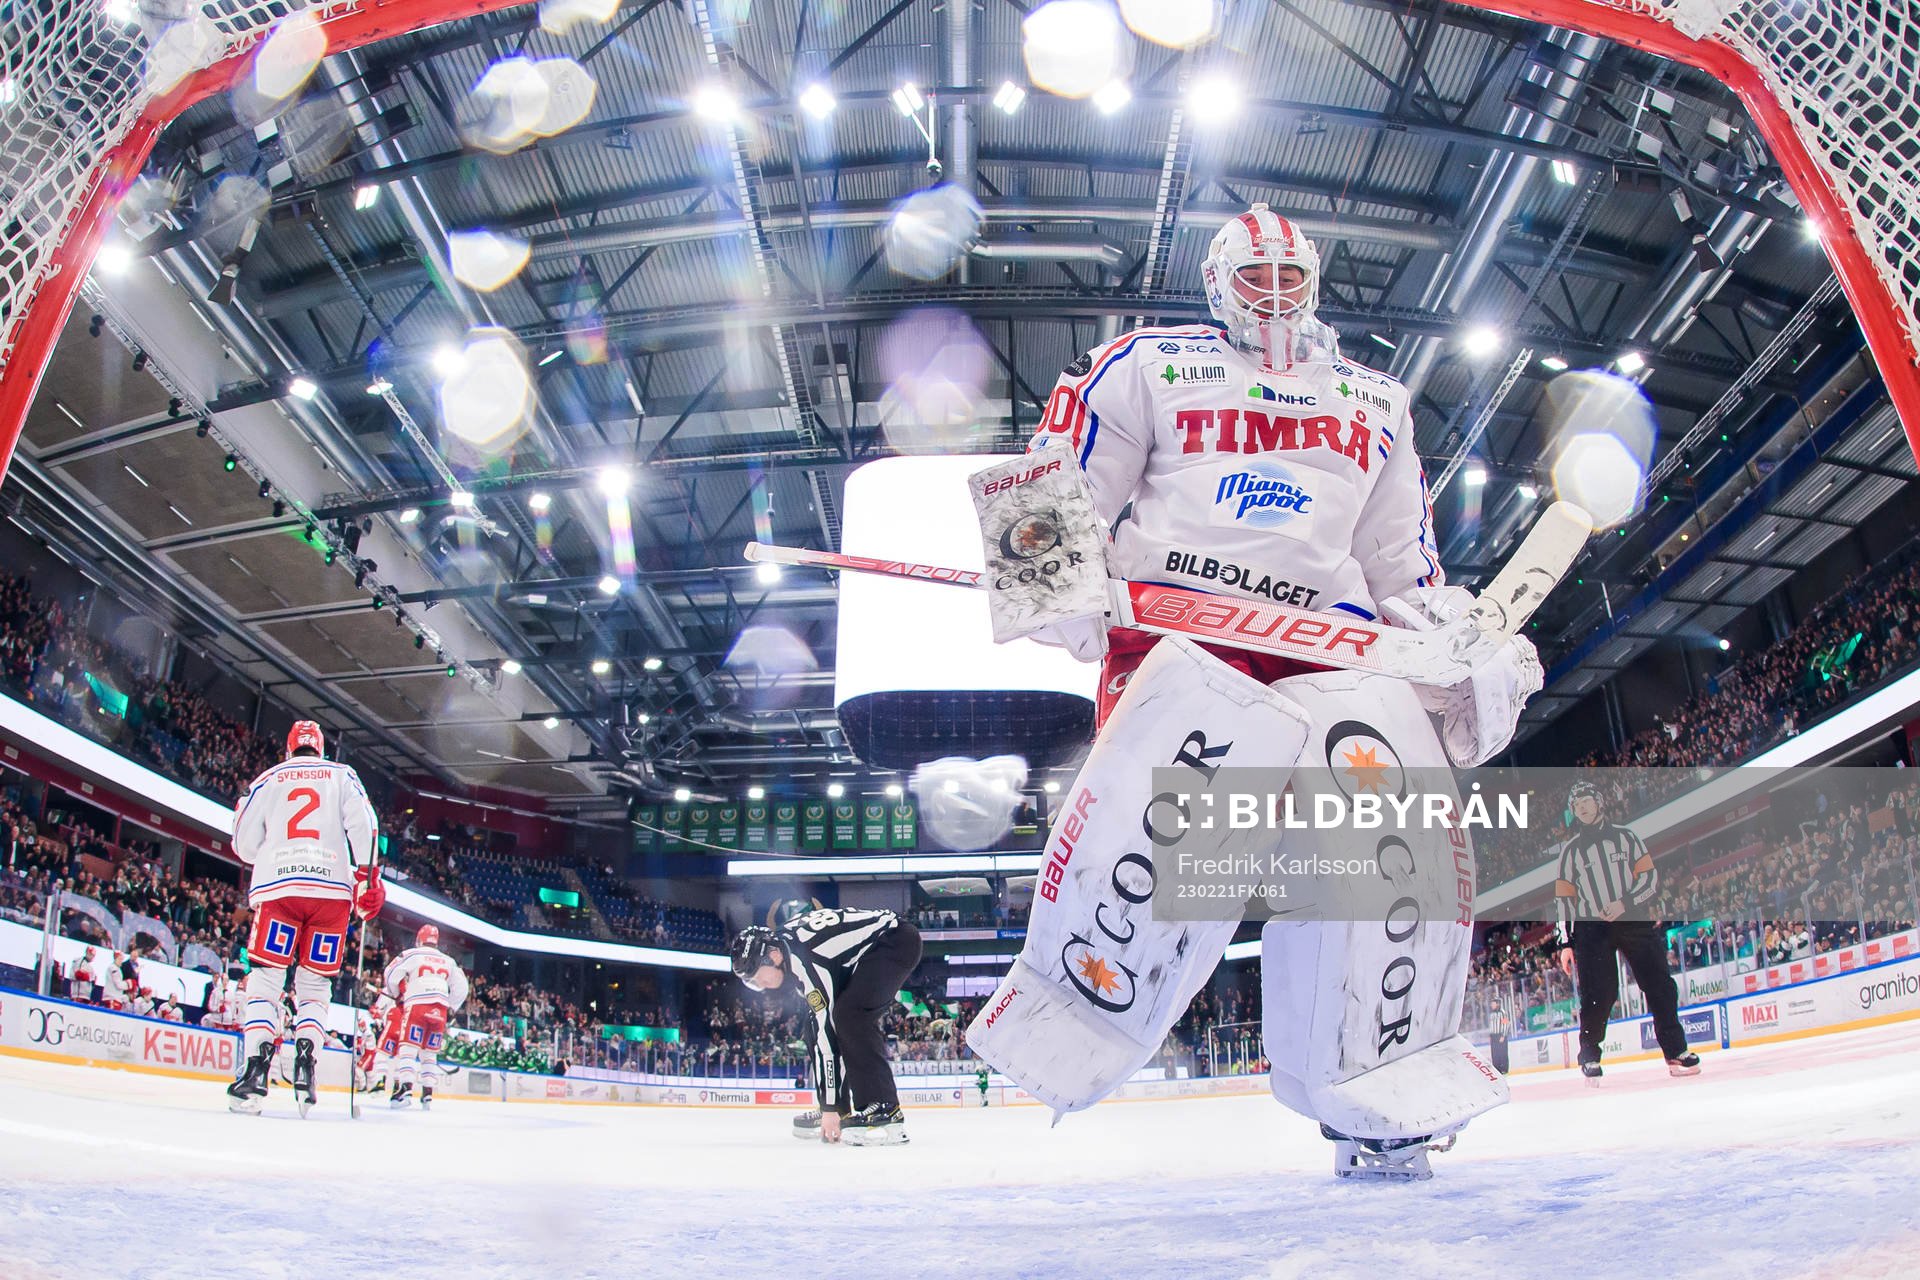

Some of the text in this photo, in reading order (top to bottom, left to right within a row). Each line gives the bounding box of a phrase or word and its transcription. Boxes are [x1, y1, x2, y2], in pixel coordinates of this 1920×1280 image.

[1185, 345, 1222, 354] SCA
[1182, 366, 1225, 380] LILIUM
[1357, 372, 1391, 388] SCA
[1278, 391, 1317, 406] NHC
[1355, 388, 1391, 413] LILIUM
[1176, 408, 1370, 474] TIMRÅ
[984, 460, 1061, 496] BAUER
[1216, 471, 1302, 505] Miami
[1236, 489, 1313, 521] pool
[994, 551, 1086, 590] COOR
[1165, 550, 1320, 608] BILBOLAGET
[1143, 593, 1379, 657] BAUER
[278, 770, 331, 782] SVENSSON
[287, 787, 320, 840] 2
[1040, 787, 1098, 904] BAUER
[278, 864, 331, 877] BILBOLAGET
[986, 987, 1018, 1029] MACH
[1742, 1004, 1778, 1025] MAXI
[144, 1028, 233, 1070] KEWAB
[1462, 1050, 1498, 1082] MACH
[709, 1090, 750, 1103] Thermia
